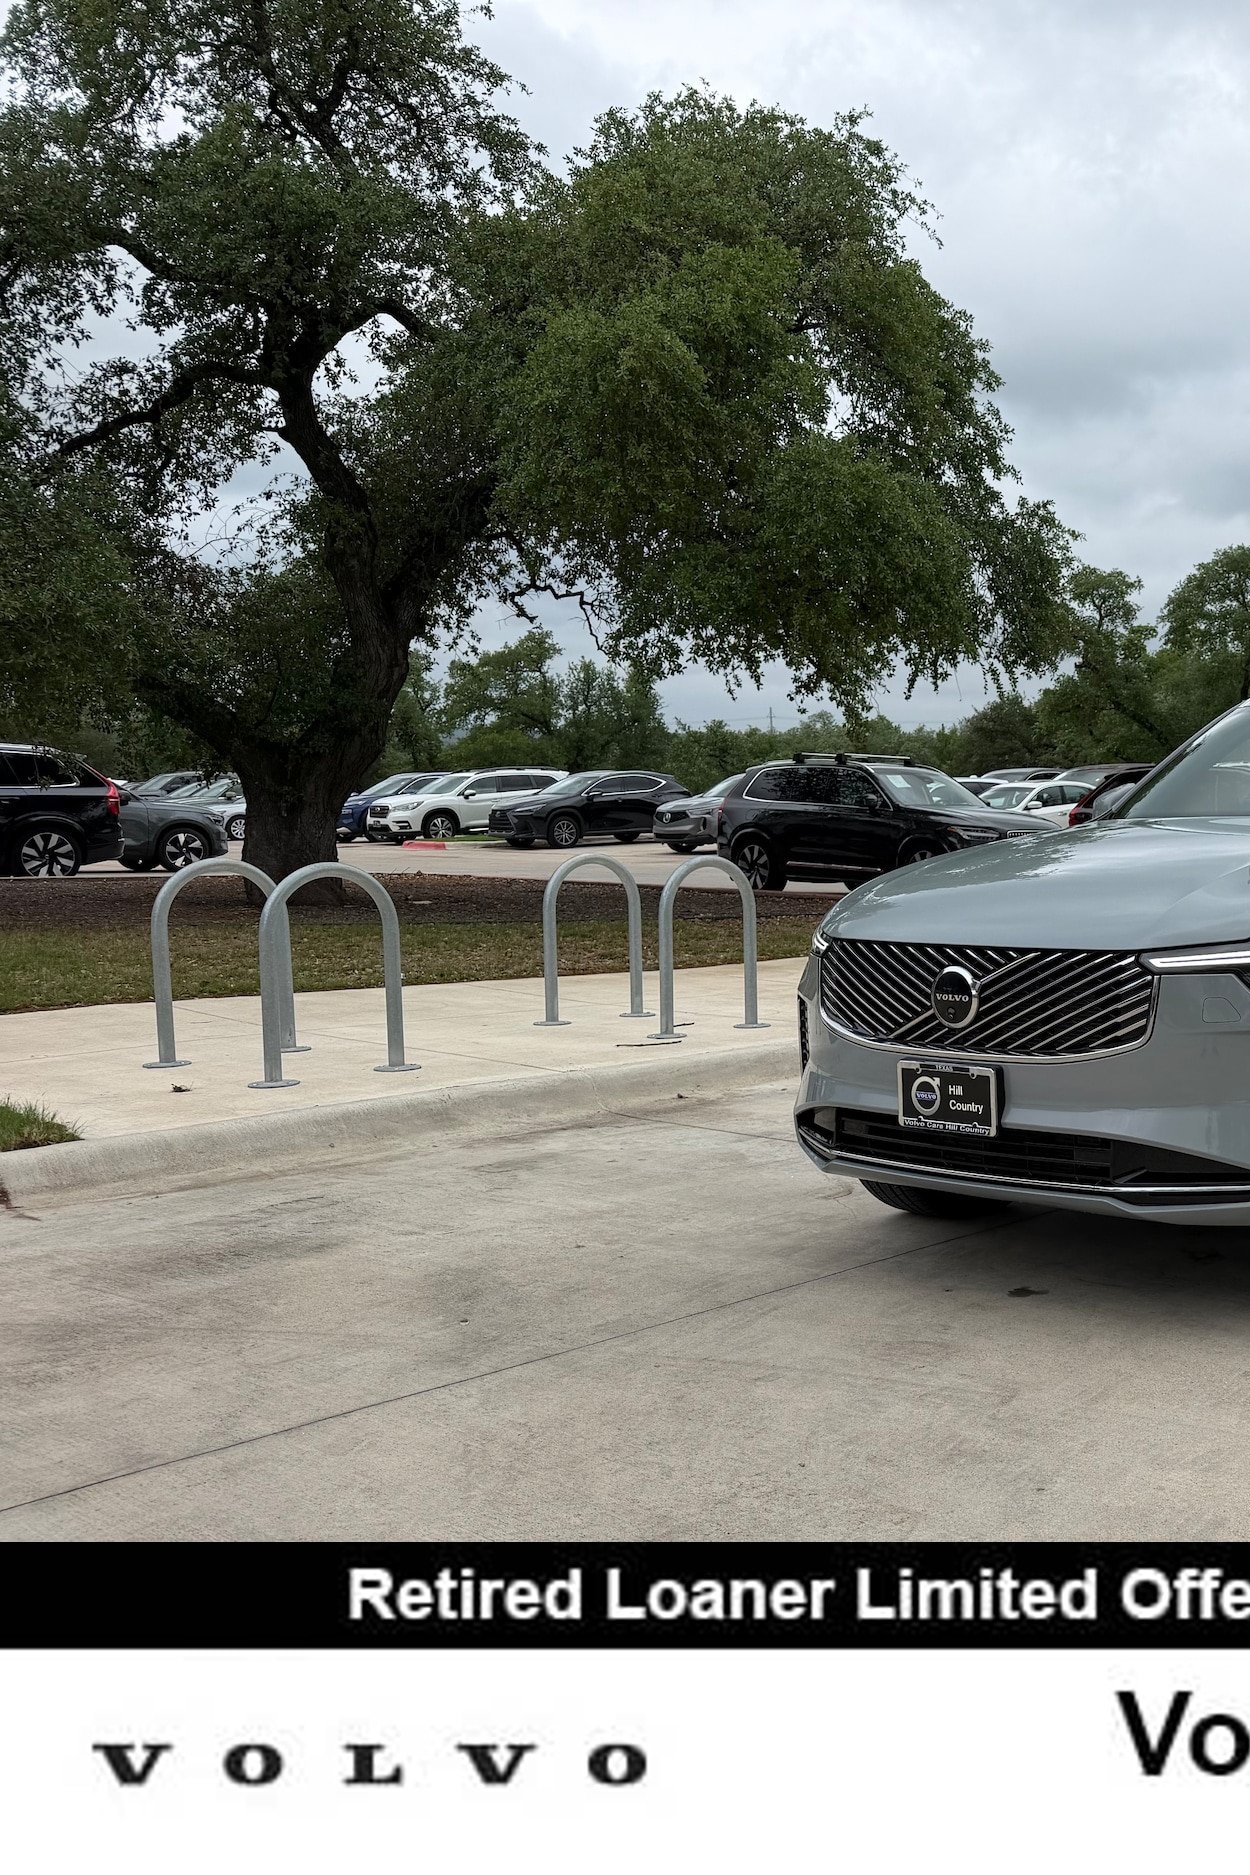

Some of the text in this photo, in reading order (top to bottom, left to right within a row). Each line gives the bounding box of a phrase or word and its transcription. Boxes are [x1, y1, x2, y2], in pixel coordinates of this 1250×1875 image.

[936, 993, 969, 1002] VOLVO
[916, 1092, 937, 1100] VOLVO
[948, 1084, 963, 1096] Hill
[949, 1099, 984, 1115] Country
[904, 1119, 990, 1136] Volvo Cars Hill Country
